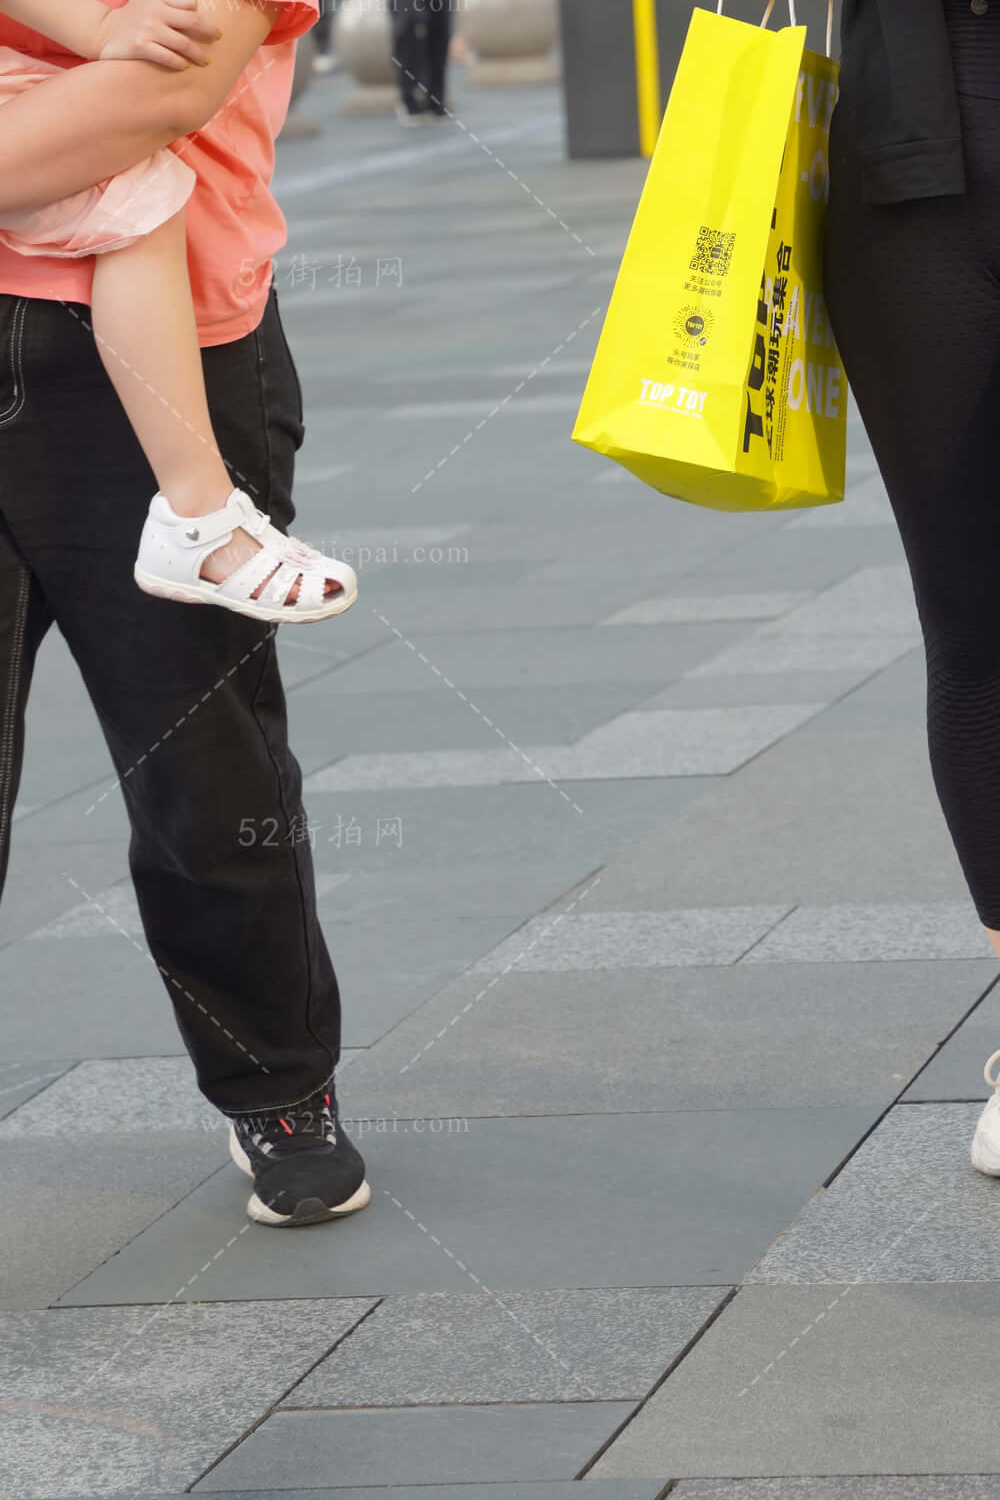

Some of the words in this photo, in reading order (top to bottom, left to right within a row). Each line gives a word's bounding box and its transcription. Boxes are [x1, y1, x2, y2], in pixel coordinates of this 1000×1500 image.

[640, 377, 675, 403] TOP
[676, 386, 708, 413] TOY
[787, 357, 842, 419] ONE
